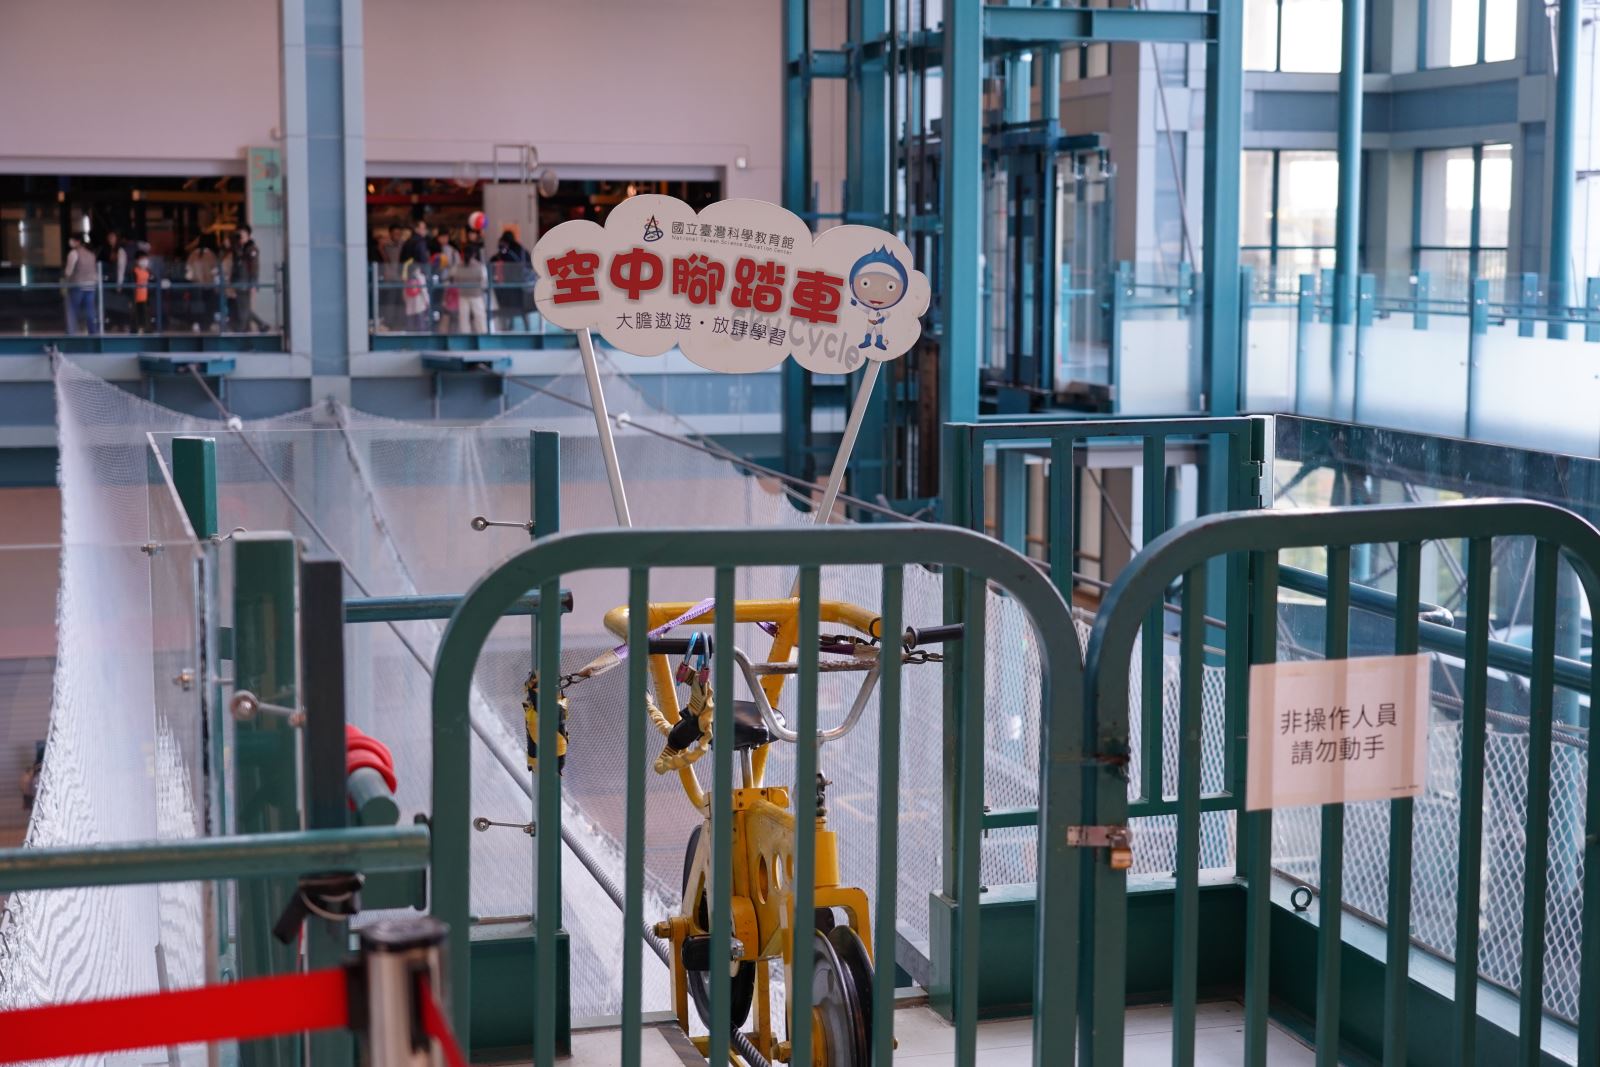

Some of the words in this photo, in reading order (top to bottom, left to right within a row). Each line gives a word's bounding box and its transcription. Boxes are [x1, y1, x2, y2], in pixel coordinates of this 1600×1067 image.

[672, 221, 795, 250] 國立臺灣科學教育館
[672, 234, 698, 242] National
[744, 243, 773, 251] Education
[546, 248, 844, 324] 空中腳踏車
[789, 317, 860, 370] Cycle
[1281, 702, 1398, 735] 非操作人員
[1291, 734, 1385, 765] 請勿動手
